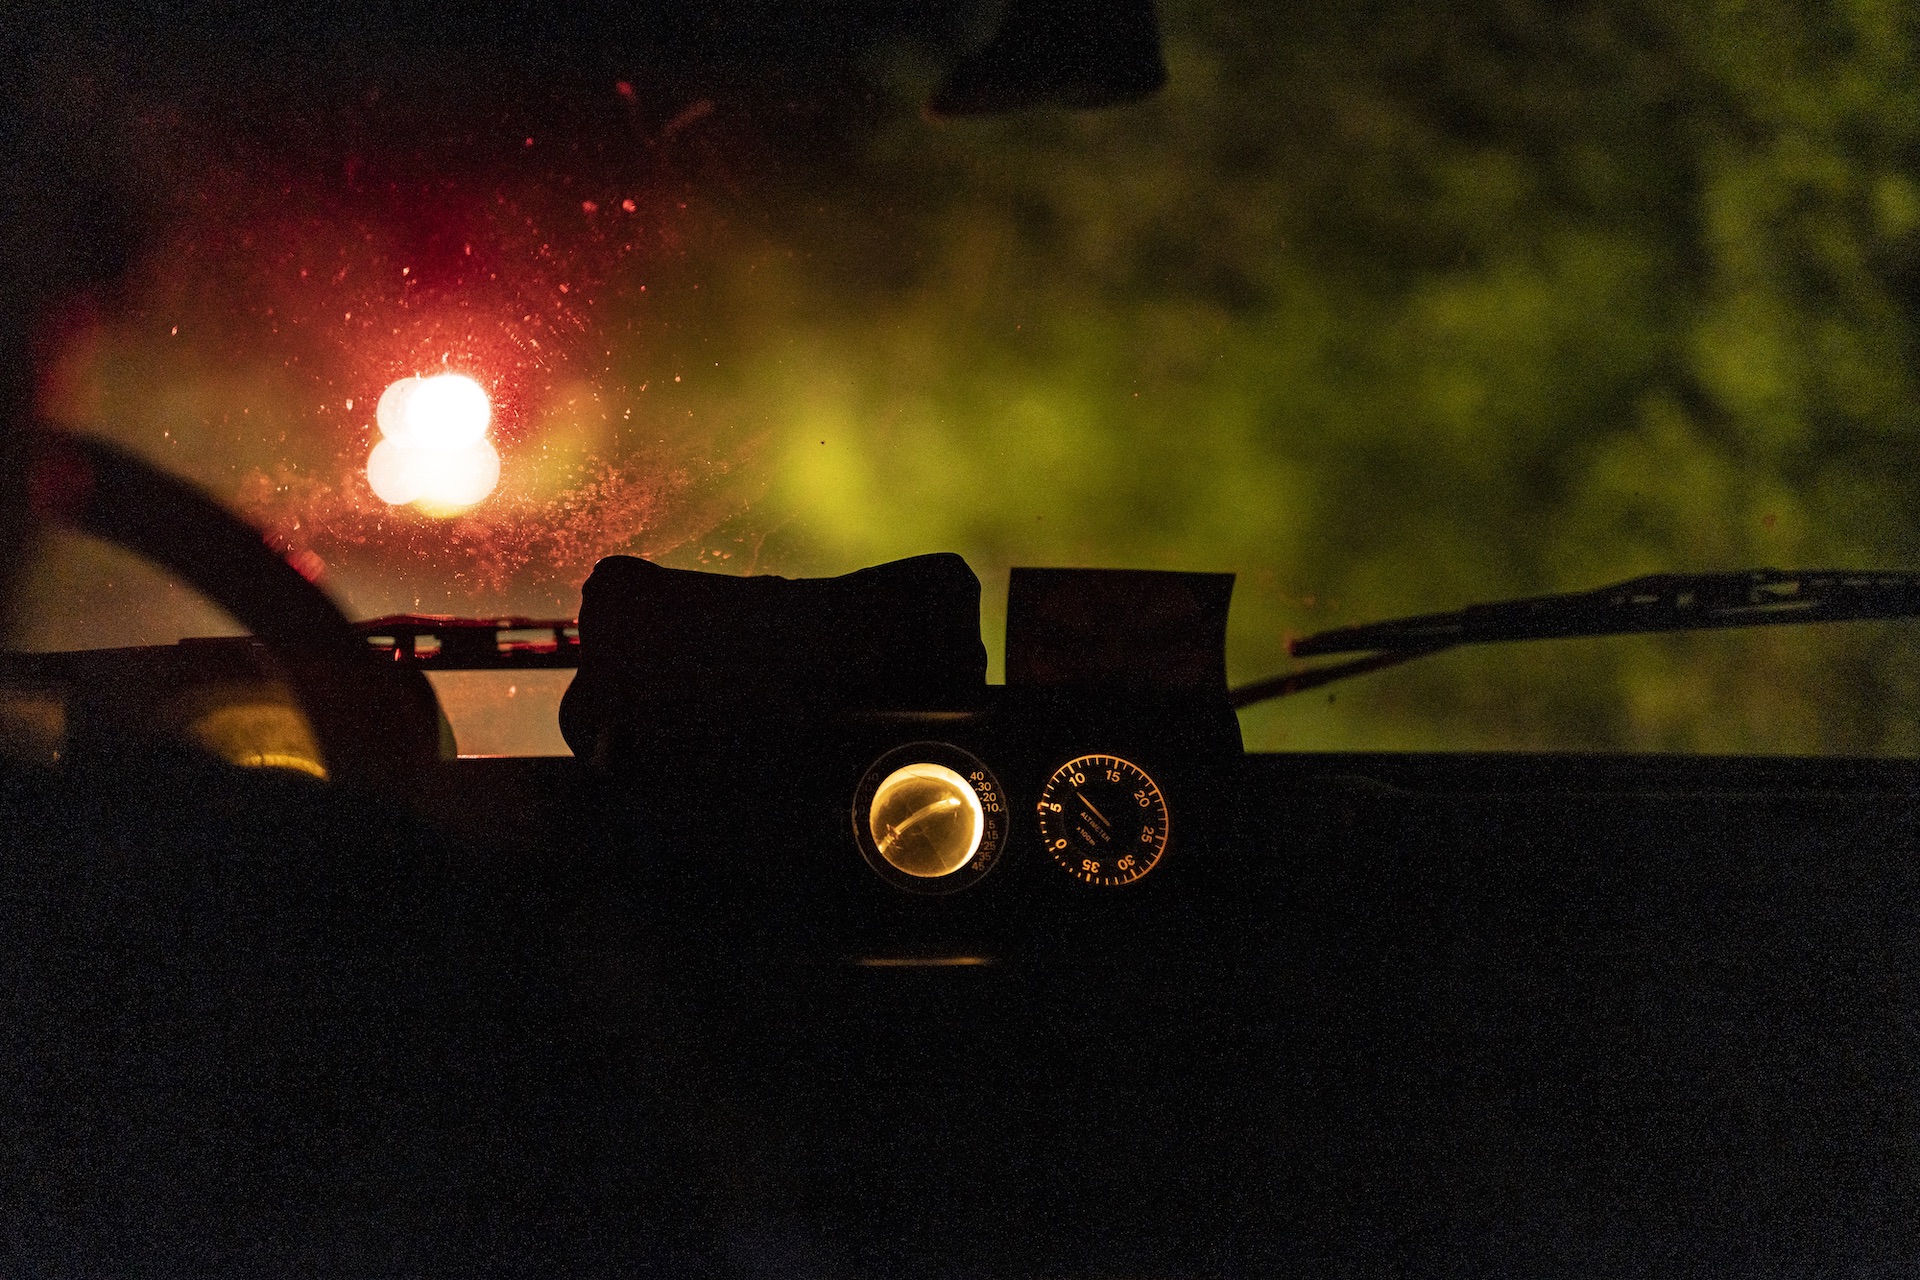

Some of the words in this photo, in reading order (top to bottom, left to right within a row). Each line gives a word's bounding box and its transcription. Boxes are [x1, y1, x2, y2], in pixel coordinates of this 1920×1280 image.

[970, 771, 984, 781] 40
[1069, 773, 1086, 787] 10
[1105, 769, 1120, 783] 15
[978, 782, 991, 791] 30
[983, 793, 996, 802] 20
[1133, 790, 1150, 807] 20
[987, 803, 998, 812] 10
[1050, 803, 1063, 812] 5
[989, 820, 995, 828] 5
[1080, 811, 1110, 842] ALTIMETER
[987, 831, 998, 839] 15
[1141, 826, 1154, 843] 25
[984, 842, 995, 850] 25
[1055, 838, 1067, 849] 0
[979, 852, 991, 861] 35
[972, 862, 984, 871] 45
[1082, 859, 1100, 872] 35
[1117, 855, 1135, 870] 30
